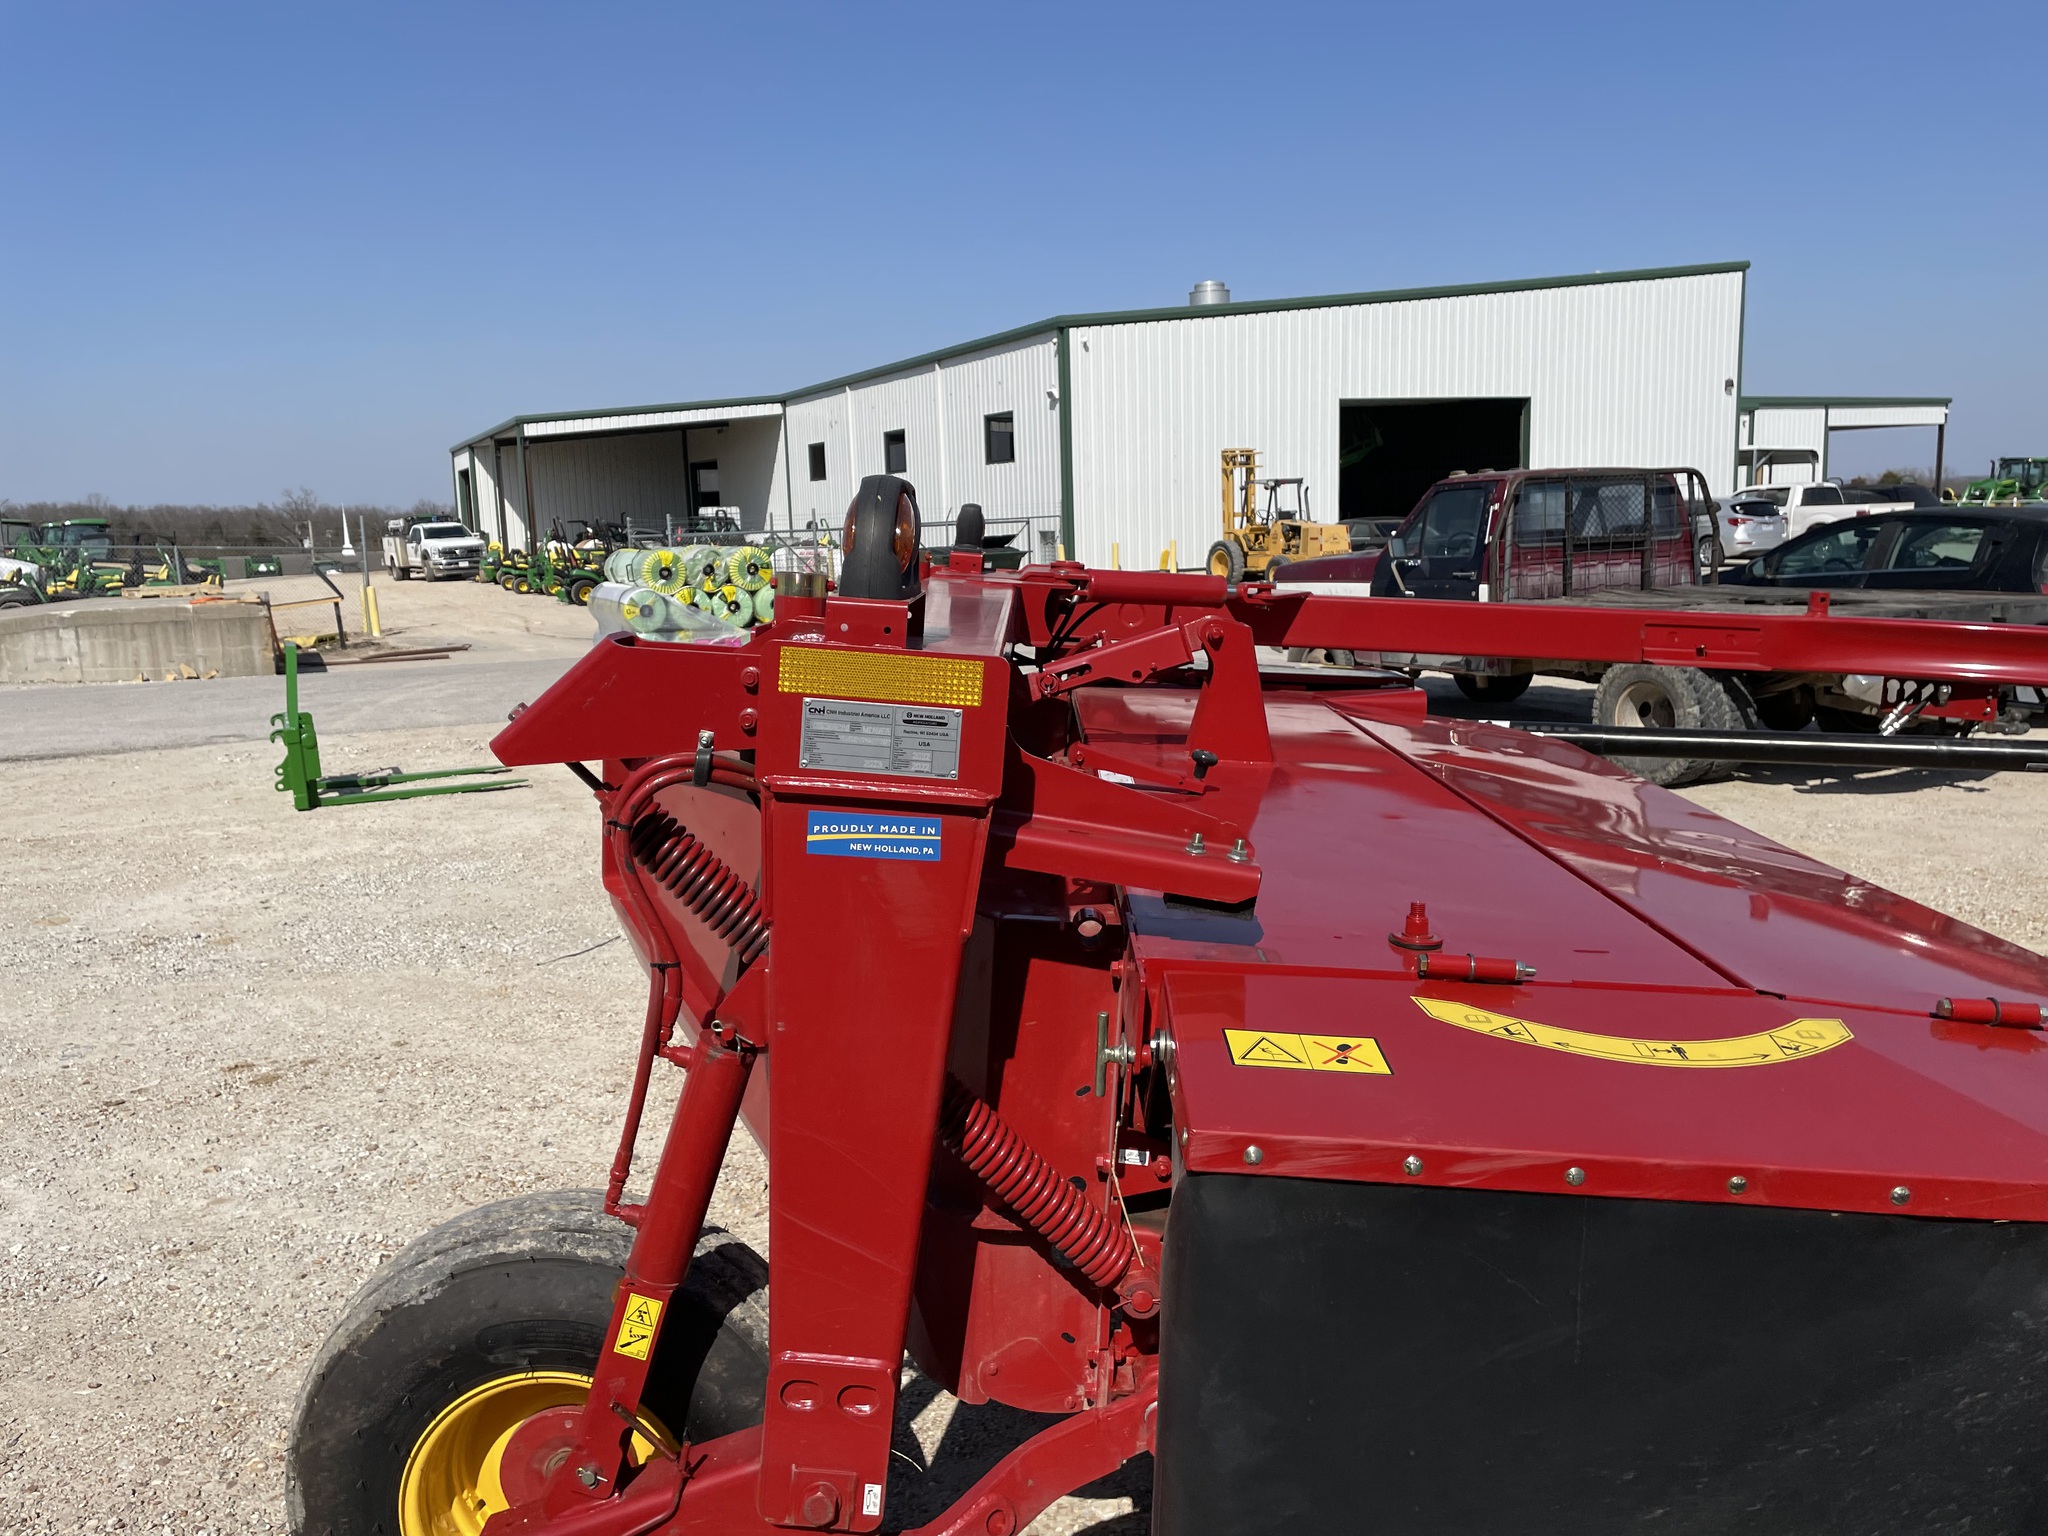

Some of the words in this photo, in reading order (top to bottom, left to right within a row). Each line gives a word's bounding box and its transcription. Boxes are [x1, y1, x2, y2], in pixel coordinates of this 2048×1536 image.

[813, 824, 874, 834] PROUDLY
[879, 825, 916, 834] MADE
[922, 826, 936, 835] IN
[849, 843, 872, 851] NEW
[874, 844, 921, 855] HOLLAND,
[922, 847, 934, 855] PA
